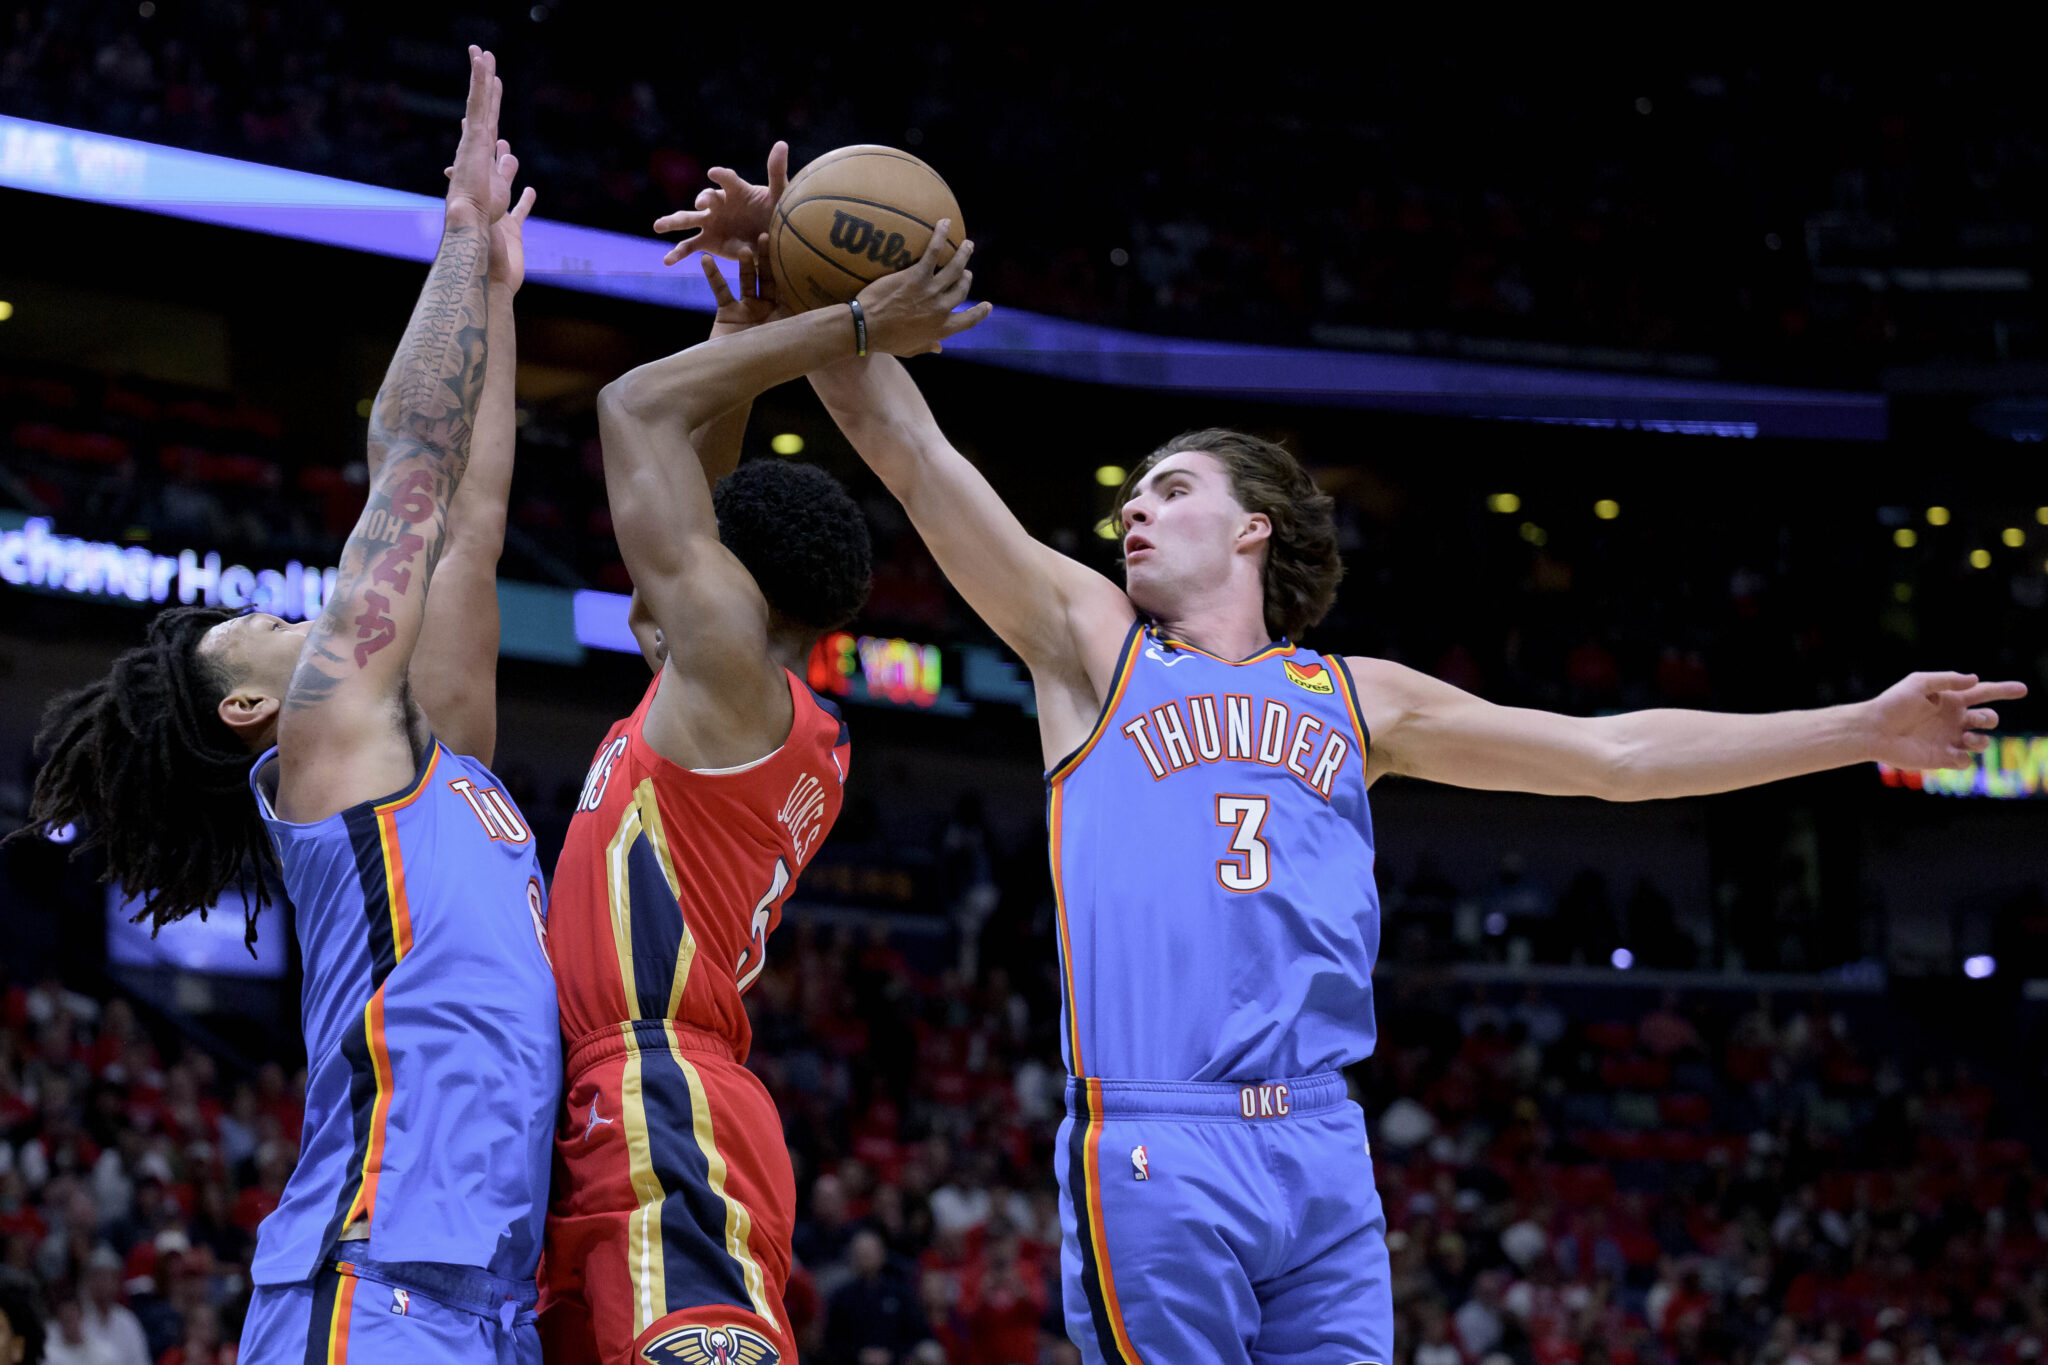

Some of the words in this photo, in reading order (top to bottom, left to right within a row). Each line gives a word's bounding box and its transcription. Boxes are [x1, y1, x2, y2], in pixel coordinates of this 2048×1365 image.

[1121, 693, 1348, 801] THUNDER
[778, 773, 825, 866] JONES
[1215, 793, 1271, 893] 3
[1240, 1084, 1290, 1118] OKC
